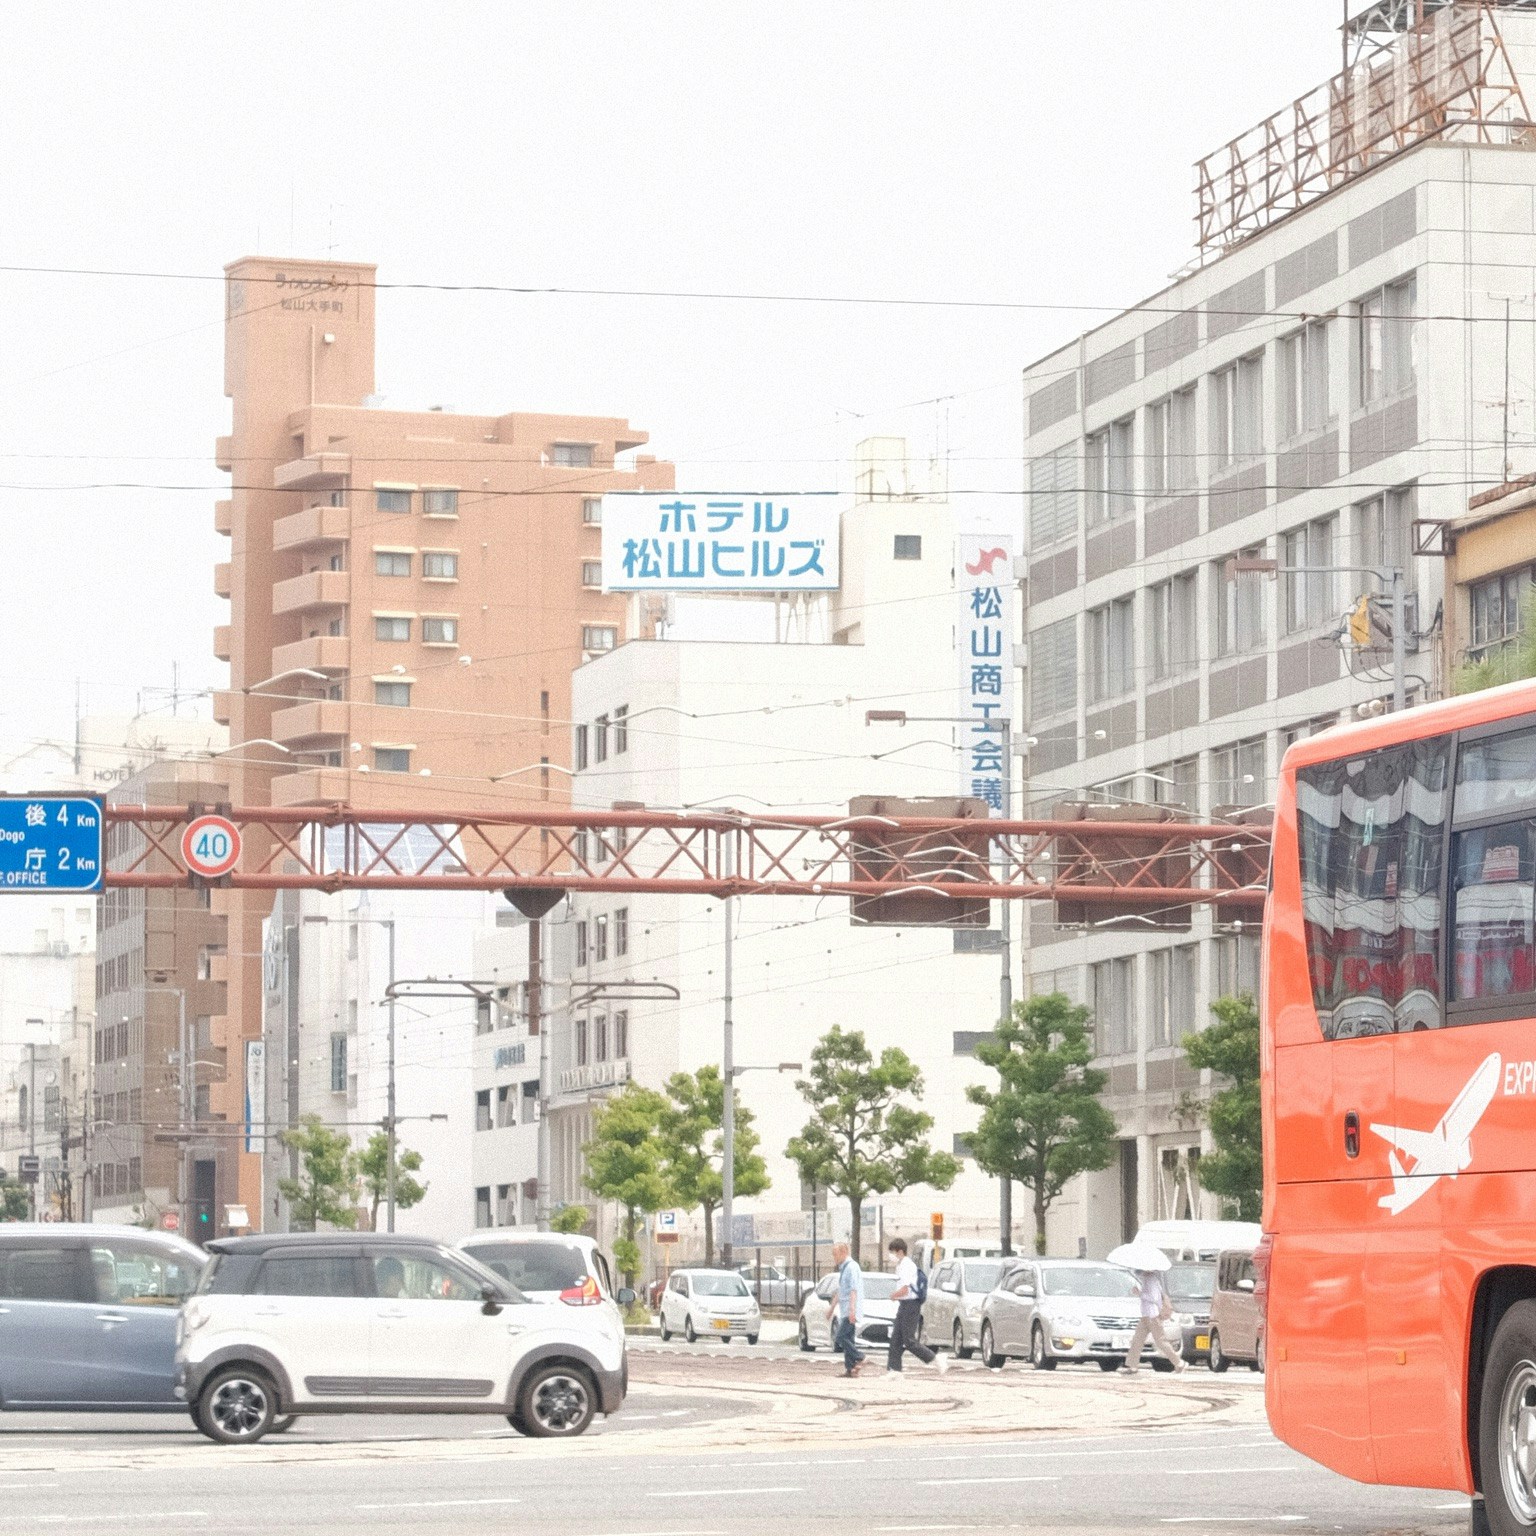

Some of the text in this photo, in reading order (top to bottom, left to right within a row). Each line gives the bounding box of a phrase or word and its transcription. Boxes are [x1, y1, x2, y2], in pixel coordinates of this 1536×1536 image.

[659, 501, 789, 532] ホテル
[622, 538, 825, 578] 松山ヒルズ
[971, 586, 1003, 848] 松山商工会議
[93, 768, 129, 782] HOTE
[57, 804, 69, 827] 4
[77, 814, 96, 827] Km
[196, 833, 227, 858] 40
[25, 847, 96, 870] 庁 2 Km
